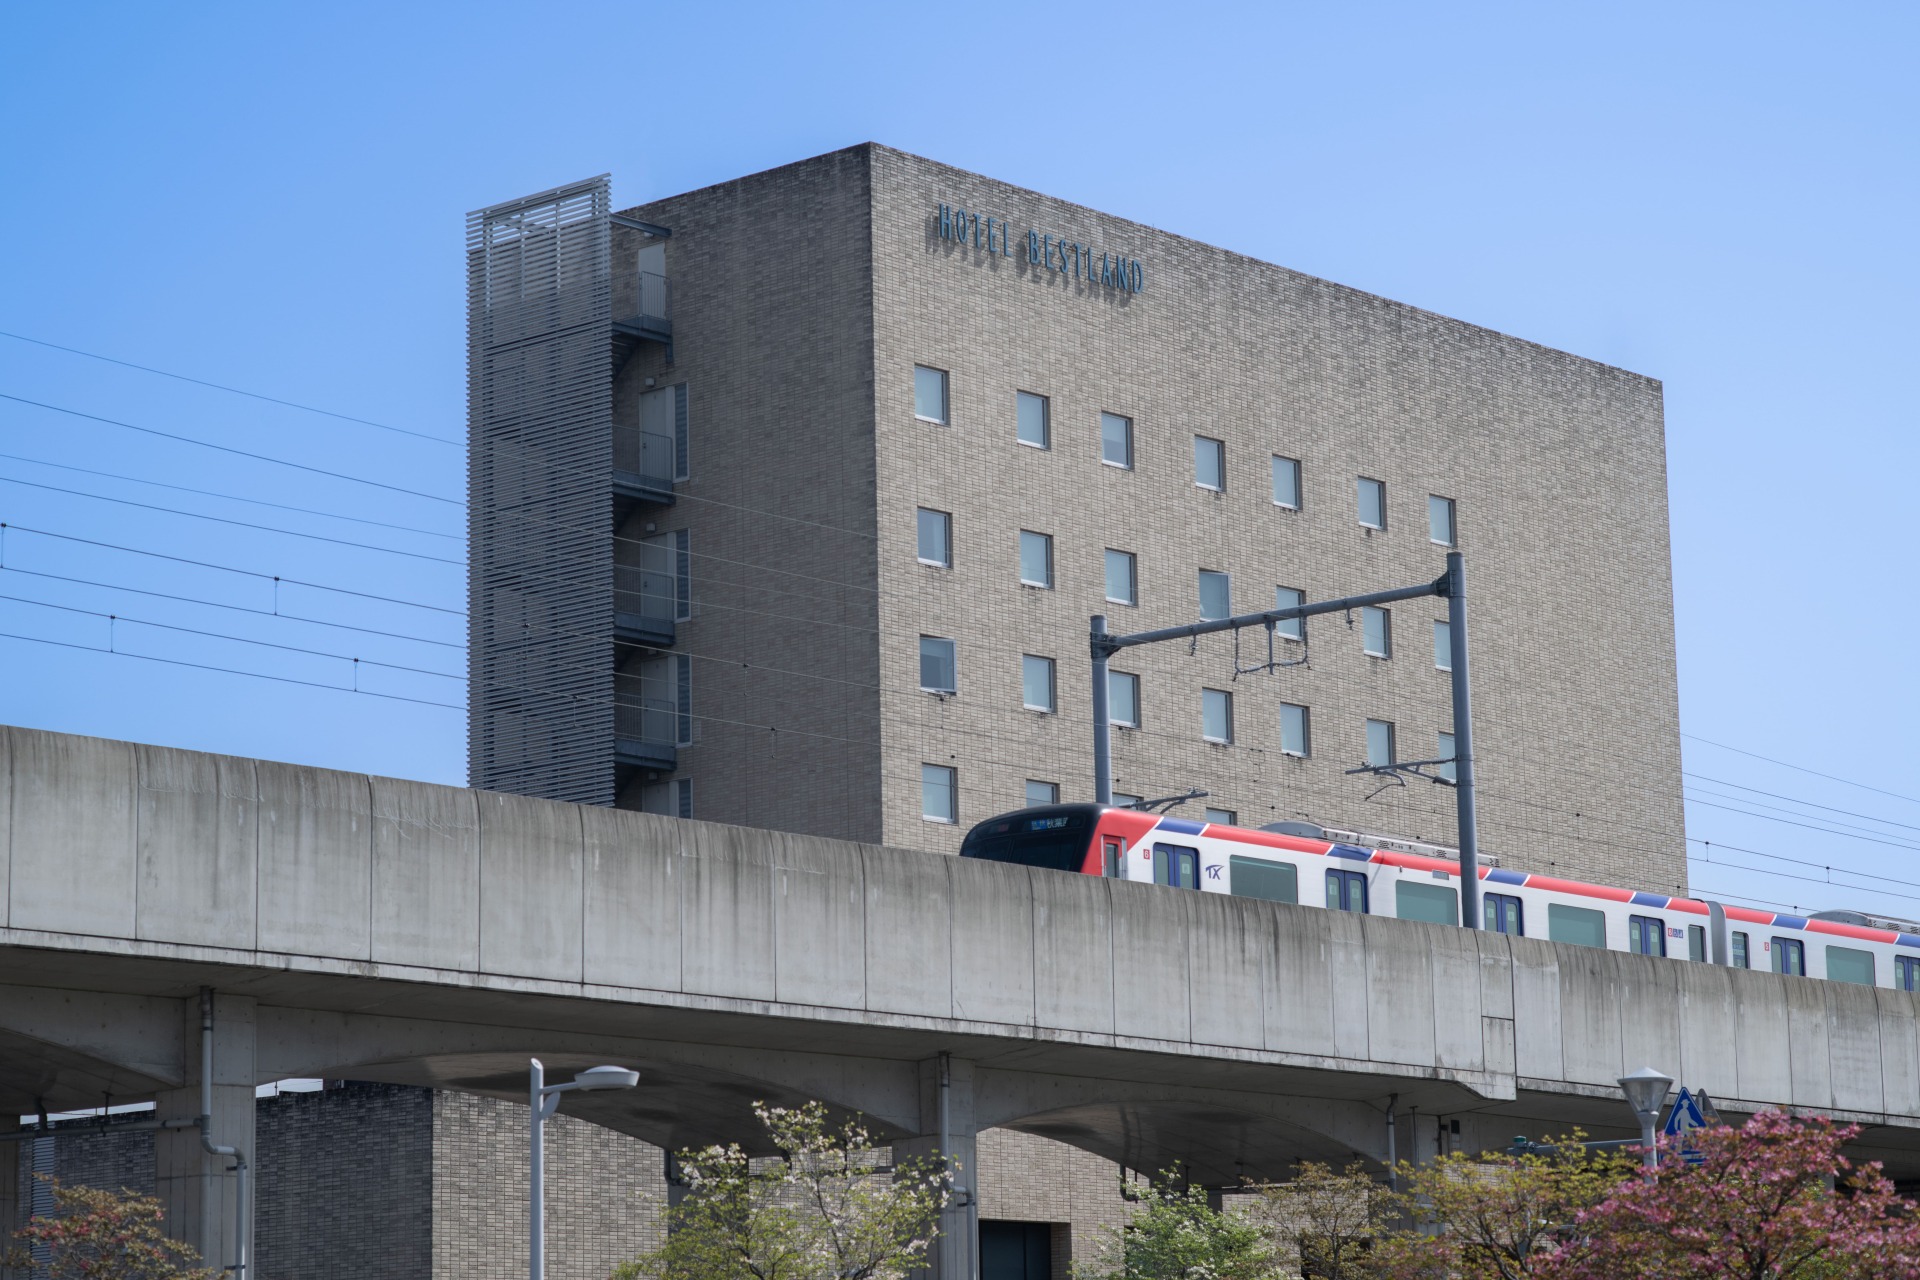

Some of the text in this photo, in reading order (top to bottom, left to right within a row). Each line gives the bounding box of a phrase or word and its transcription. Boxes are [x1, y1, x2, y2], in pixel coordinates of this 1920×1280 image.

[939, 203, 1143, 294] HOTEL BESTLAND
[1144, 850, 1149, 859] 6
[1205, 864, 1224, 880] TX
